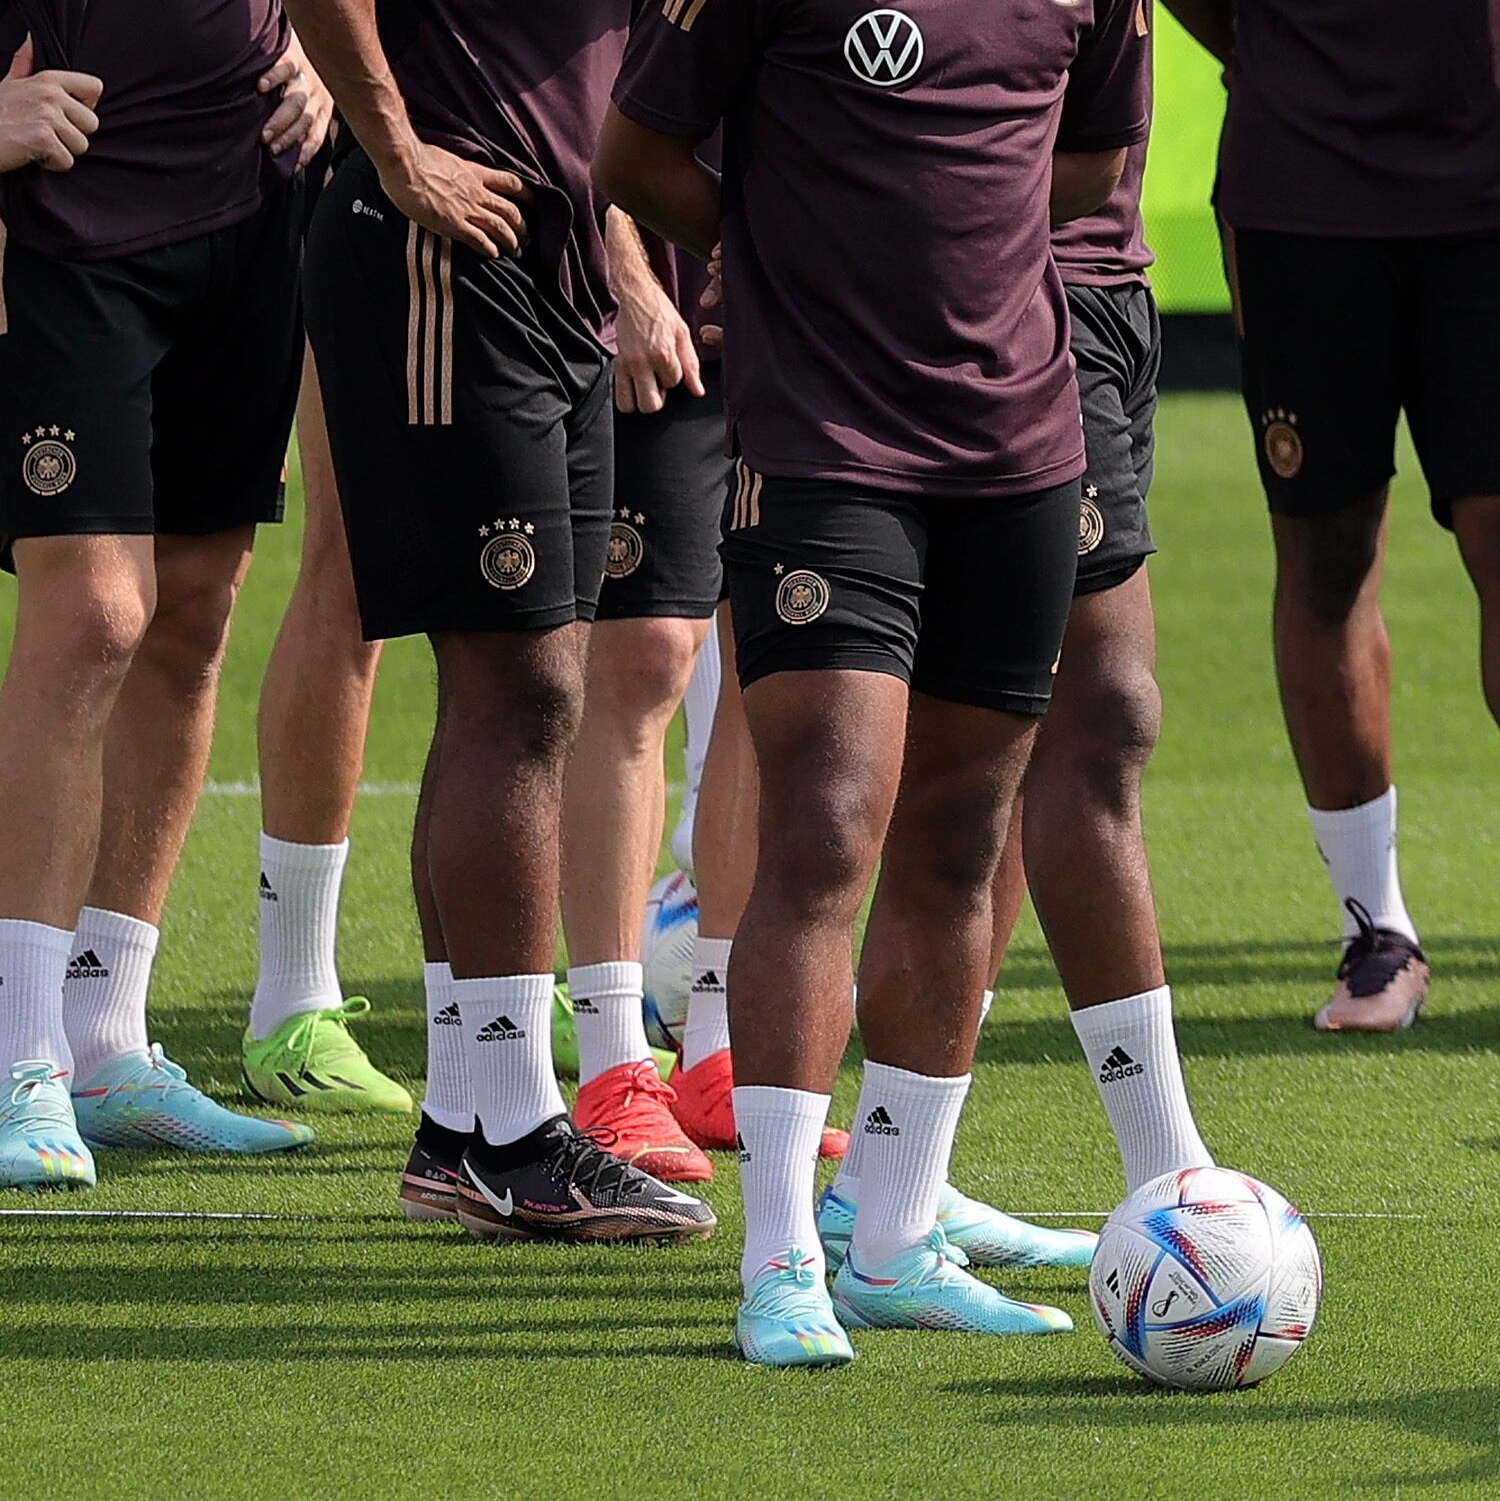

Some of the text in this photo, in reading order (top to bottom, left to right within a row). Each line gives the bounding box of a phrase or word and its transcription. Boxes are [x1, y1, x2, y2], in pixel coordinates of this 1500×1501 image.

[845, 9, 923, 85] VW
[476, 1027, 526, 1042] adidas
[1099, 1061, 1144, 1084] adidas
[864, 1121, 900, 1136] adidas
